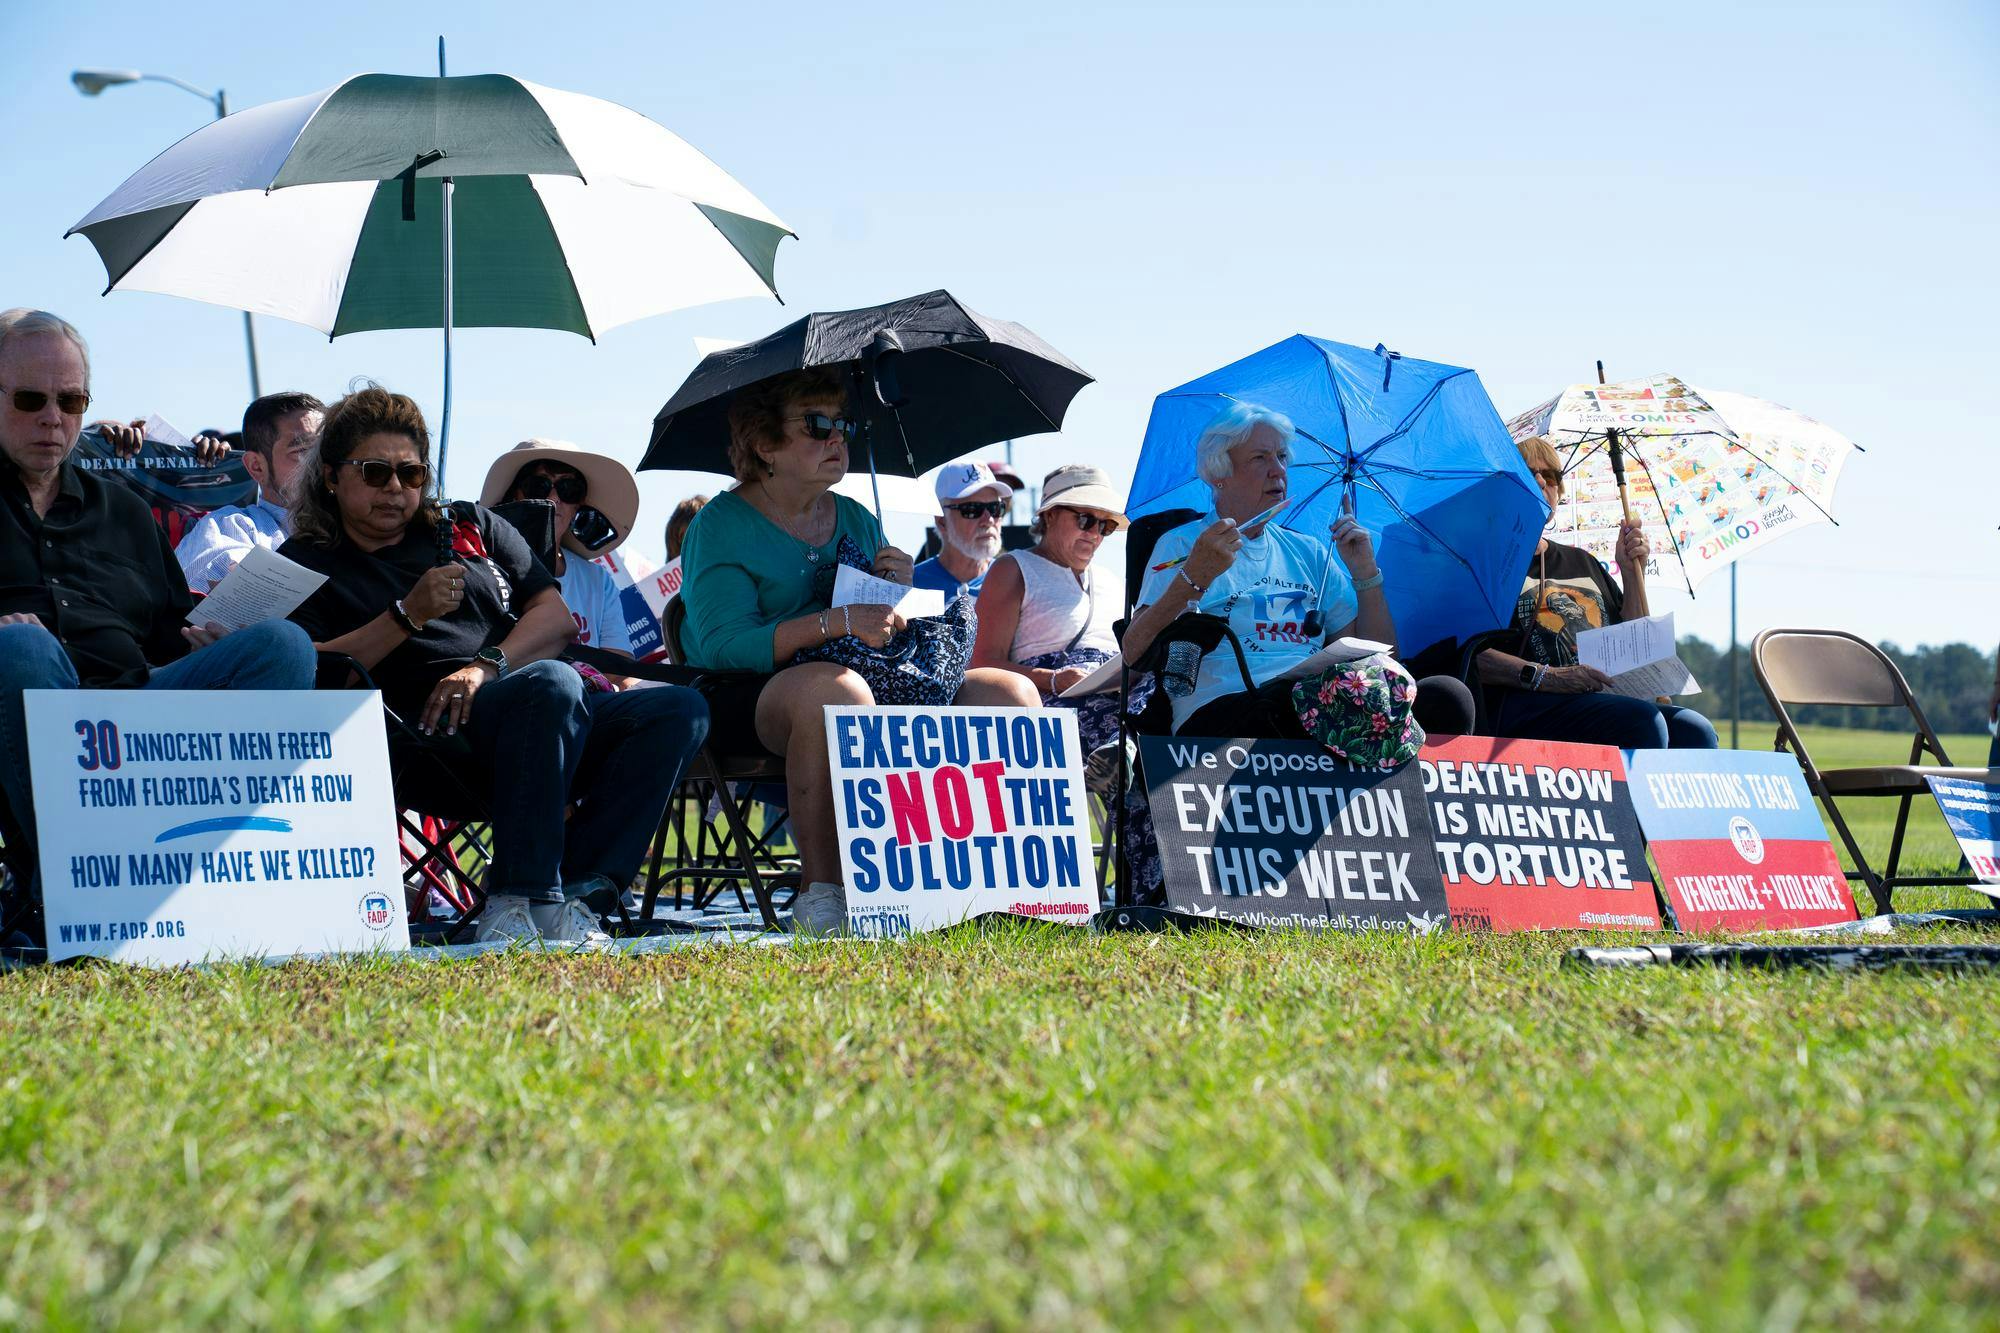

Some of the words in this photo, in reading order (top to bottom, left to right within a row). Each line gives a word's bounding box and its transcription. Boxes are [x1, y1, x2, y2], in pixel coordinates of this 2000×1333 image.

[1619, 413, 1696, 425] COMICS
[81, 457, 137, 470] DEATH
[144, 456, 217, 470] PENAL
[75, 719, 121, 771] 30
[124, 732, 223, 762] INNOCENT
[229, 732, 273, 761] MEN
[278, 731, 333, 760] FREED
[835, 714, 1067, 769] EXECUTION
[1167, 744, 1218, 769] We
[1226, 745, 1335, 776] Oppose
[79, 777, 137, 807] FROM
[142, 776, 241, 806] FLORIDA'S
[249, 775, 305, 804] DEATH
[311, 774, 352, 802] ROW
[1418, 760, 1530, 798] DEATH
[1534, 765, 1614, 803] ROW
[1646, 773, 1750, 809] EXECUTIONS
[1744, 774, 1800, 810] TEACH
[842, 777, 886, 829] IS
[885, 760, 1008, 847] NOT
[1004, 778, 1075, 826] THE
[1172, 783, 1410, 838] EXECUTION
[1434, 801, 1469, 836] IS
[1474, 803, 1616, 842] MENTAL
[71, 855, 121, 888] HOW
[128, 852, 193, 886] MANY
[201, 850, 256, 883] HAVE
[260, 849, 293, 881] WE
[298, 847, 375, 879] KILLED?
[850, 834, 1081, 893] SOLUTION
[1186, 846, 1289, 898] THIS
[1293, 849, 1421, 902] WEEK
[1435, 841, 1635, 892] TORTURE
[850, 905, 875, 913] DEATH
[877, 904, 910, 912] PENALTY
[1008, 902, 1090, 916] #StopExecutions
[1674, 875, 1766, 912] VENGENCE
[1768, 875, 1847, 911] VIOLENCE
[59, 920, 185, 942] WWW.FADP.ORG
[367, 910, 388, 924] FADP
[1219, 911, 1406, 932] ForWhomTheBellsTollorg
